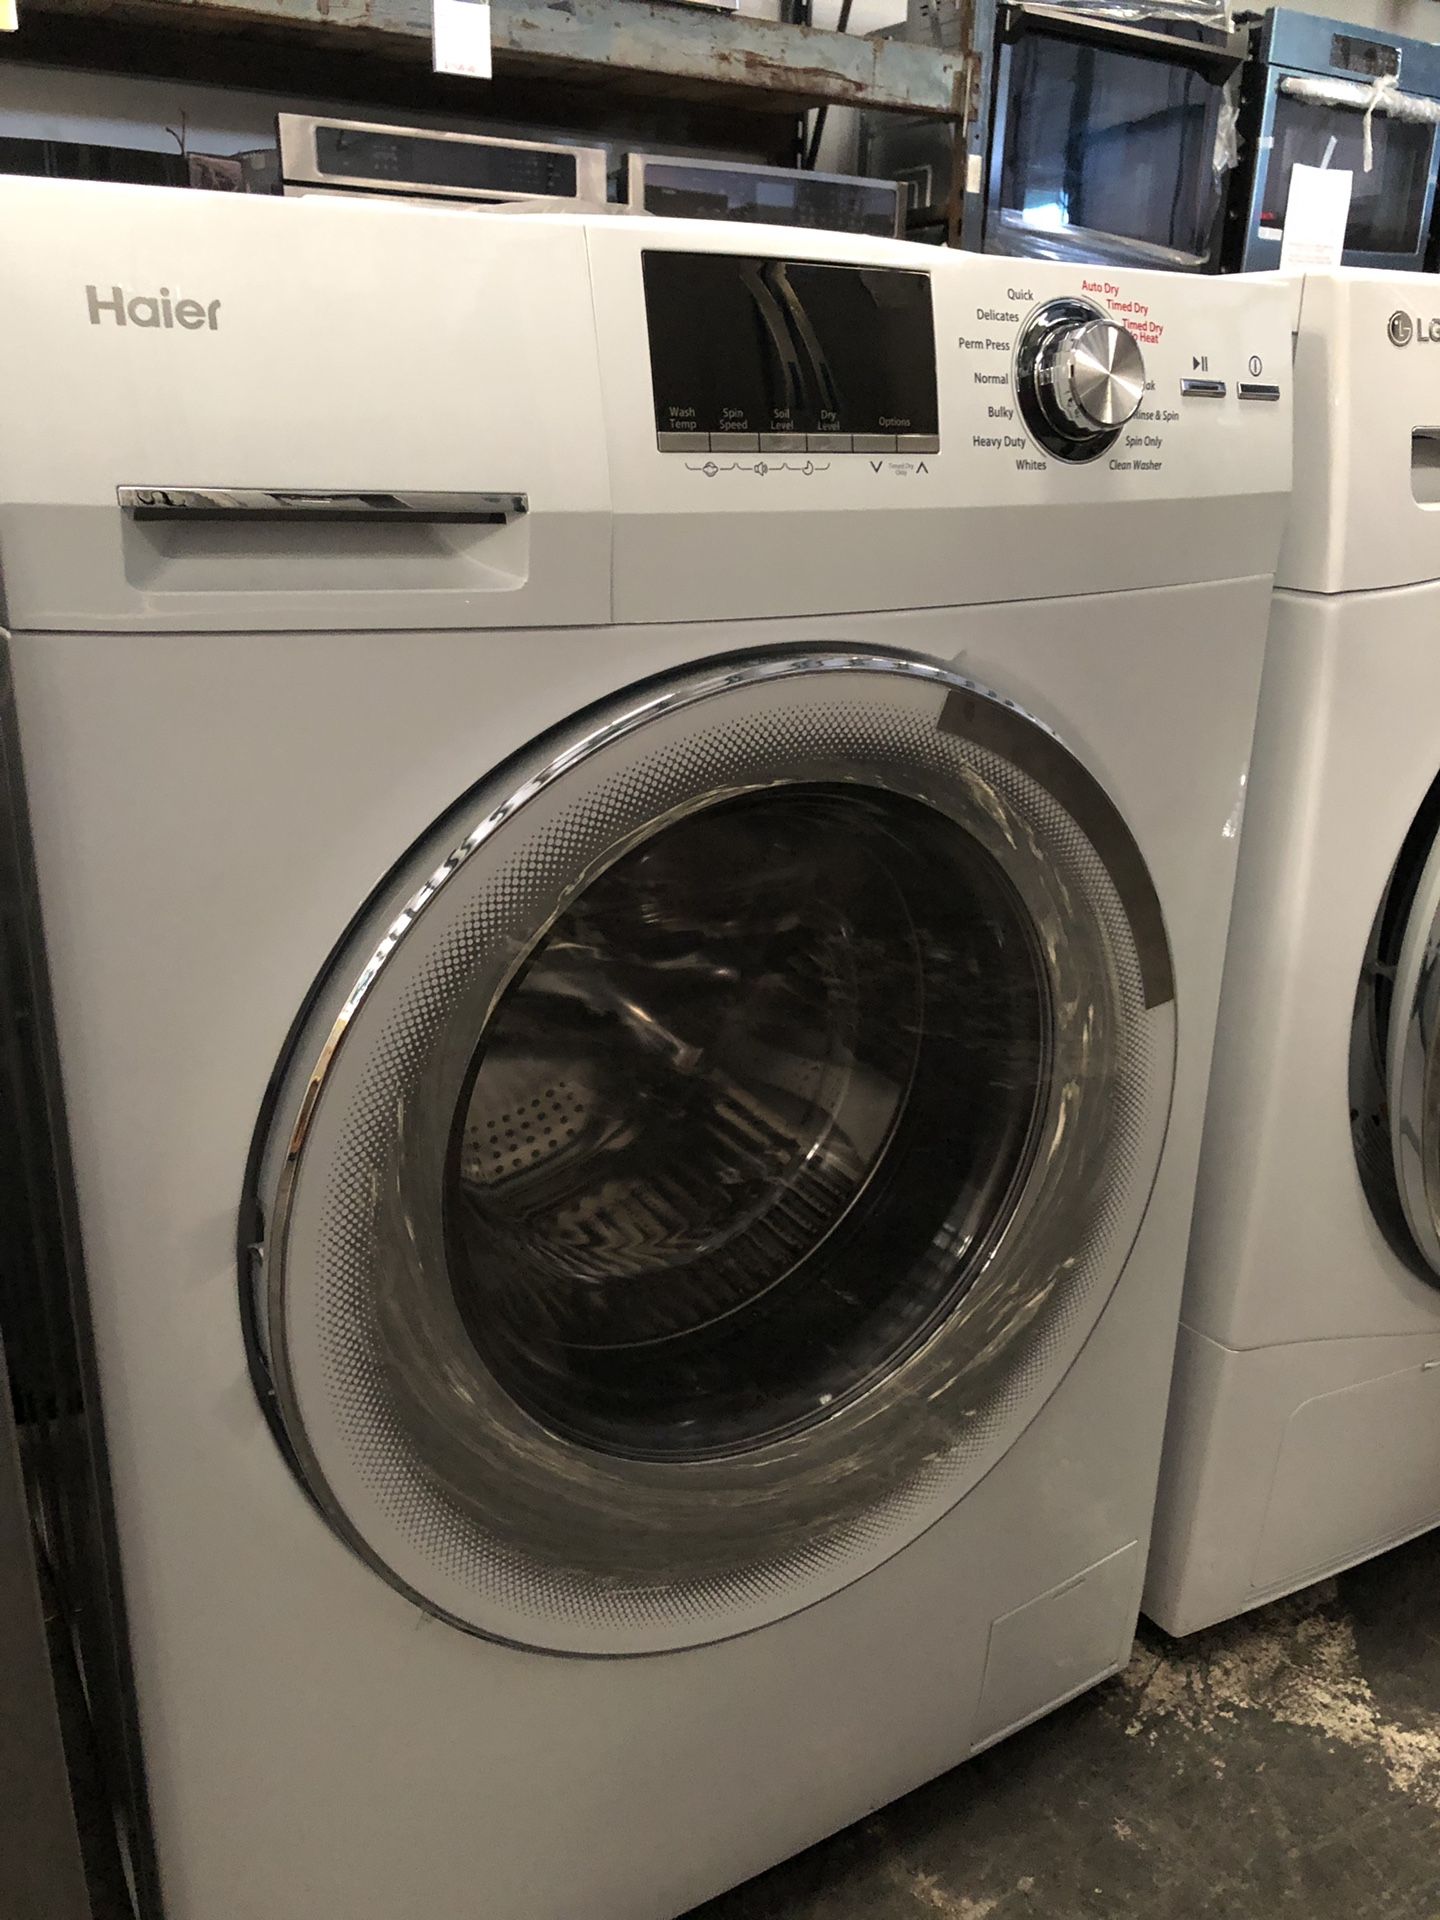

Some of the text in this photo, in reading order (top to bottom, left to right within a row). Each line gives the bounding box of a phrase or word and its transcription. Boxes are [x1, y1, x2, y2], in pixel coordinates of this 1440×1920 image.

[1082, 280, 1119, 297] Auto Dry
[1007, 288, 1034, 301] Quick
[85, 285, 221, 330] Haier
[1107, 299, 1149, 316] Timed Dry
[976, 308, 1019, 322] Delicates
[1122, 319, 1164, 335] Timed Dry
[1140, 332, 1159, 344] Heat
[959, 338, 1010, 351] Perm Press
[974, 373, 1009, 384] Normal
[669, 407, 695, 417] Wash
[723, 408, 744, 419] Spin
[774, 409, 790, 418] Soil
[821, 410, 837, 421] Dry
[988, 407, 1014, 420] Bulky
[1155, 411, 1161, 420] &
[1163, 411, 1179, 422] Spin
[669, 419, 697, 430] Temp
[720, 420, 748, 431] Speed
[771, 421, 794, 430] Level
[818, 421, 840, 431] Level
[878, 417, 911, 427] Options
[973, 436, 1026, 450] Heavy Duty
[1126, 436, 1162, 449] Spin Only
[1016, 460, 1047, 470] Whites
[1109, 460, 1162, 470] Clean Washer
